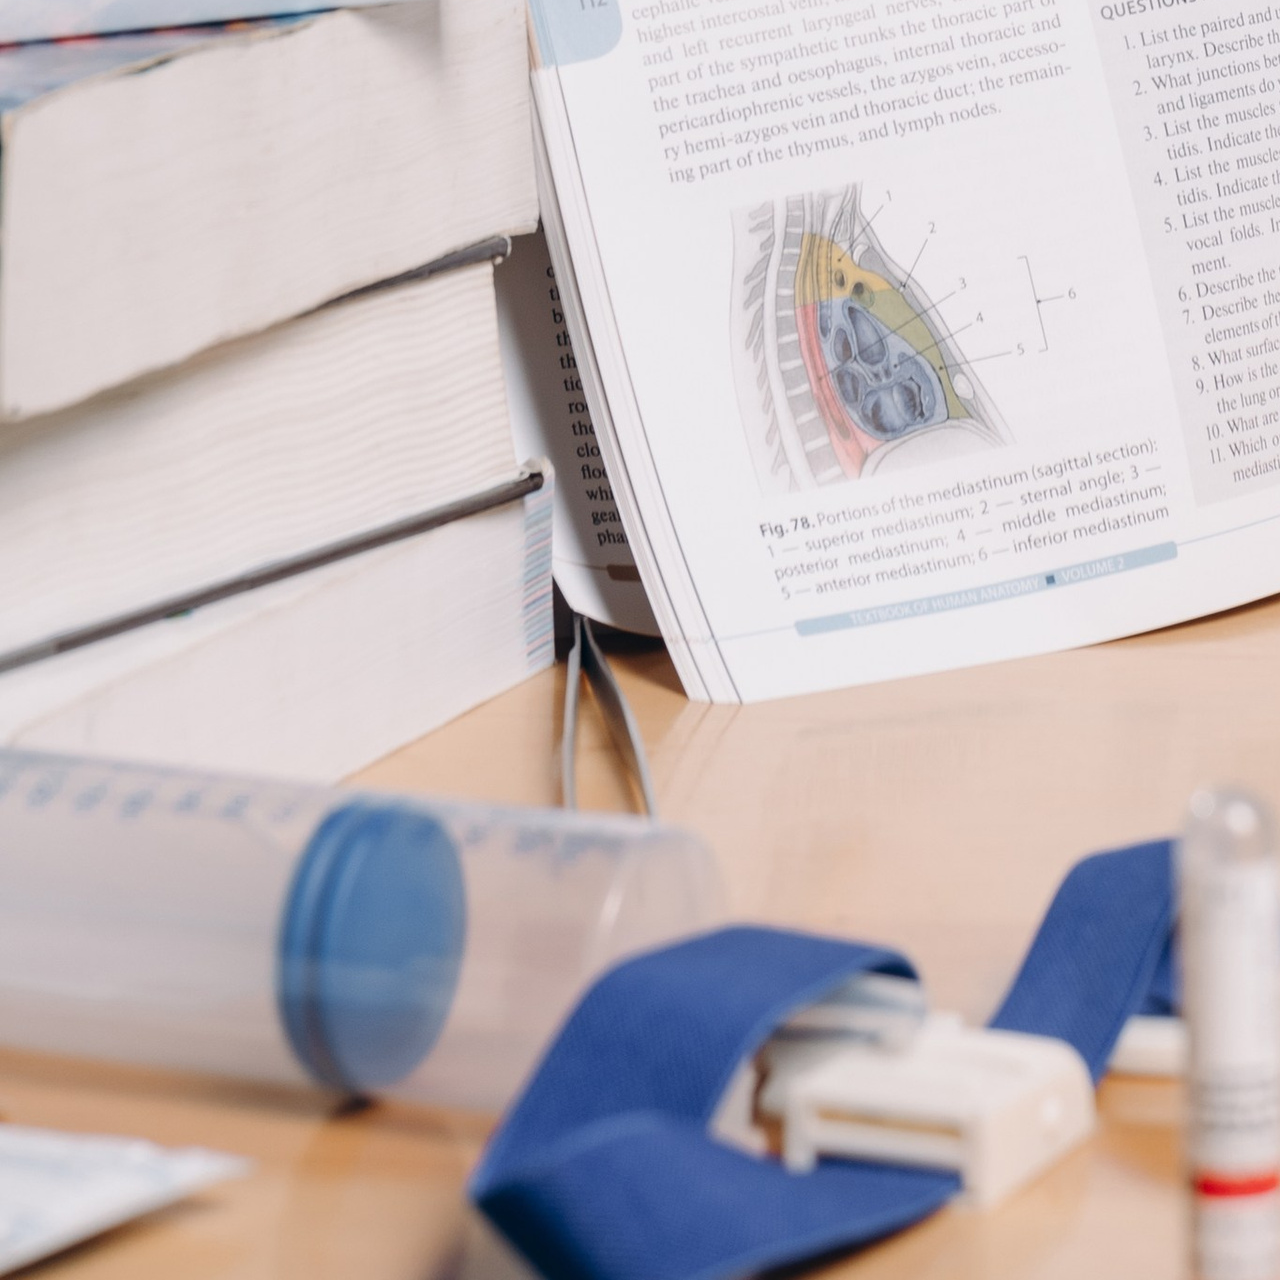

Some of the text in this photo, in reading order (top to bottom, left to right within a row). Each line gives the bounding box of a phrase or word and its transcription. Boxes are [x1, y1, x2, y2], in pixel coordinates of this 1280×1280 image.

[670, 103, 1001, 182] ing part of the thymus, and lymph nodes.
[929, 222, 936, 234] 2
[959, 277, 967, 289] 3
[1068, 288, 1076, 299] 6
[976, 312, 983, 322] 4
[1017, 343, 1025, 356] 5
[760, 439, 1158, 537] Fig. 78. Portions of the mediastinum (sagittal section):
[851, 557, 1125, 627] TEXTBOOK OF HUMAN ANATOMY VOLUME 2
